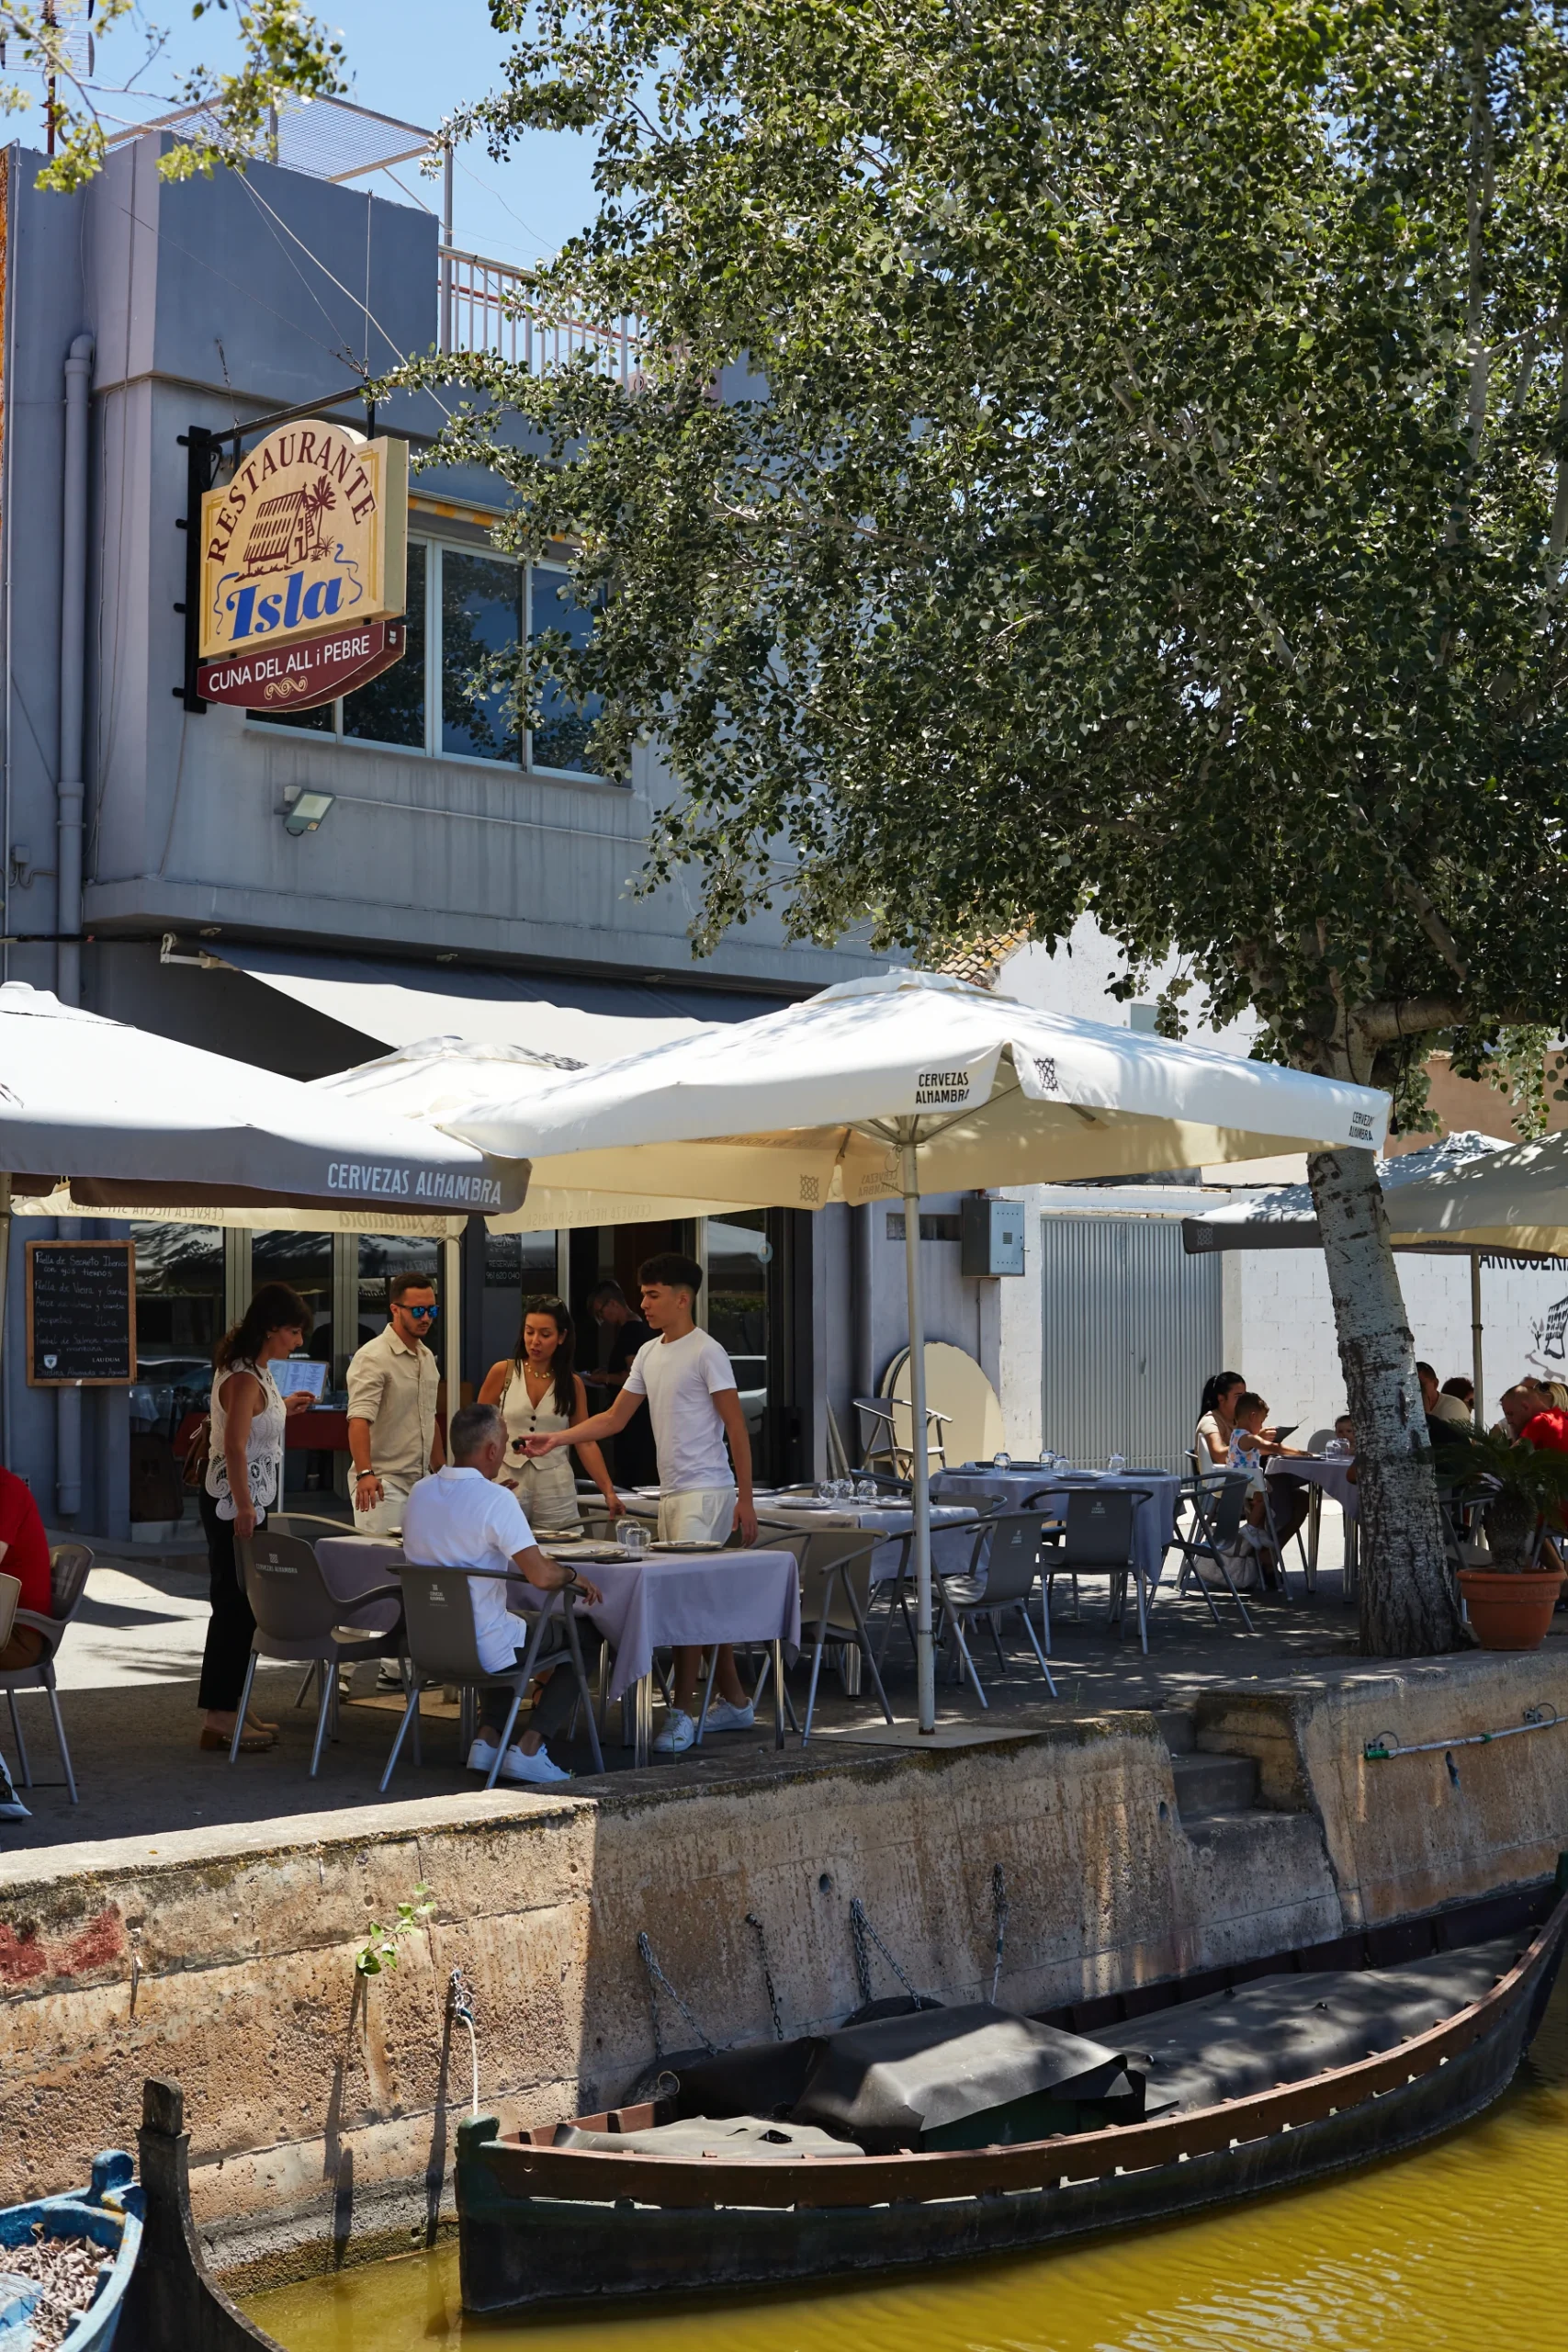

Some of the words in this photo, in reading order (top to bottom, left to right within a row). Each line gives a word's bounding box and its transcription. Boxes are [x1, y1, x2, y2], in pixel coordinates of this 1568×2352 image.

[207, 431, 378, 566] RESTAURANTE
[226, 571, 344, 641] Isla
[209, 665, 253, 692] CUNA
[255, 660, 283, 682] DEL
[287, 651, 313, 675] ALL
[316, 651, 321, 668] i
[323, 634, 371, 664] PEBRE
[919, 1071, 969, 1088] CERVEZAS
[328, 1162, 410, 1195] CERVEZAS
[415, 1170, 502, 1205] ALHAMBRA
